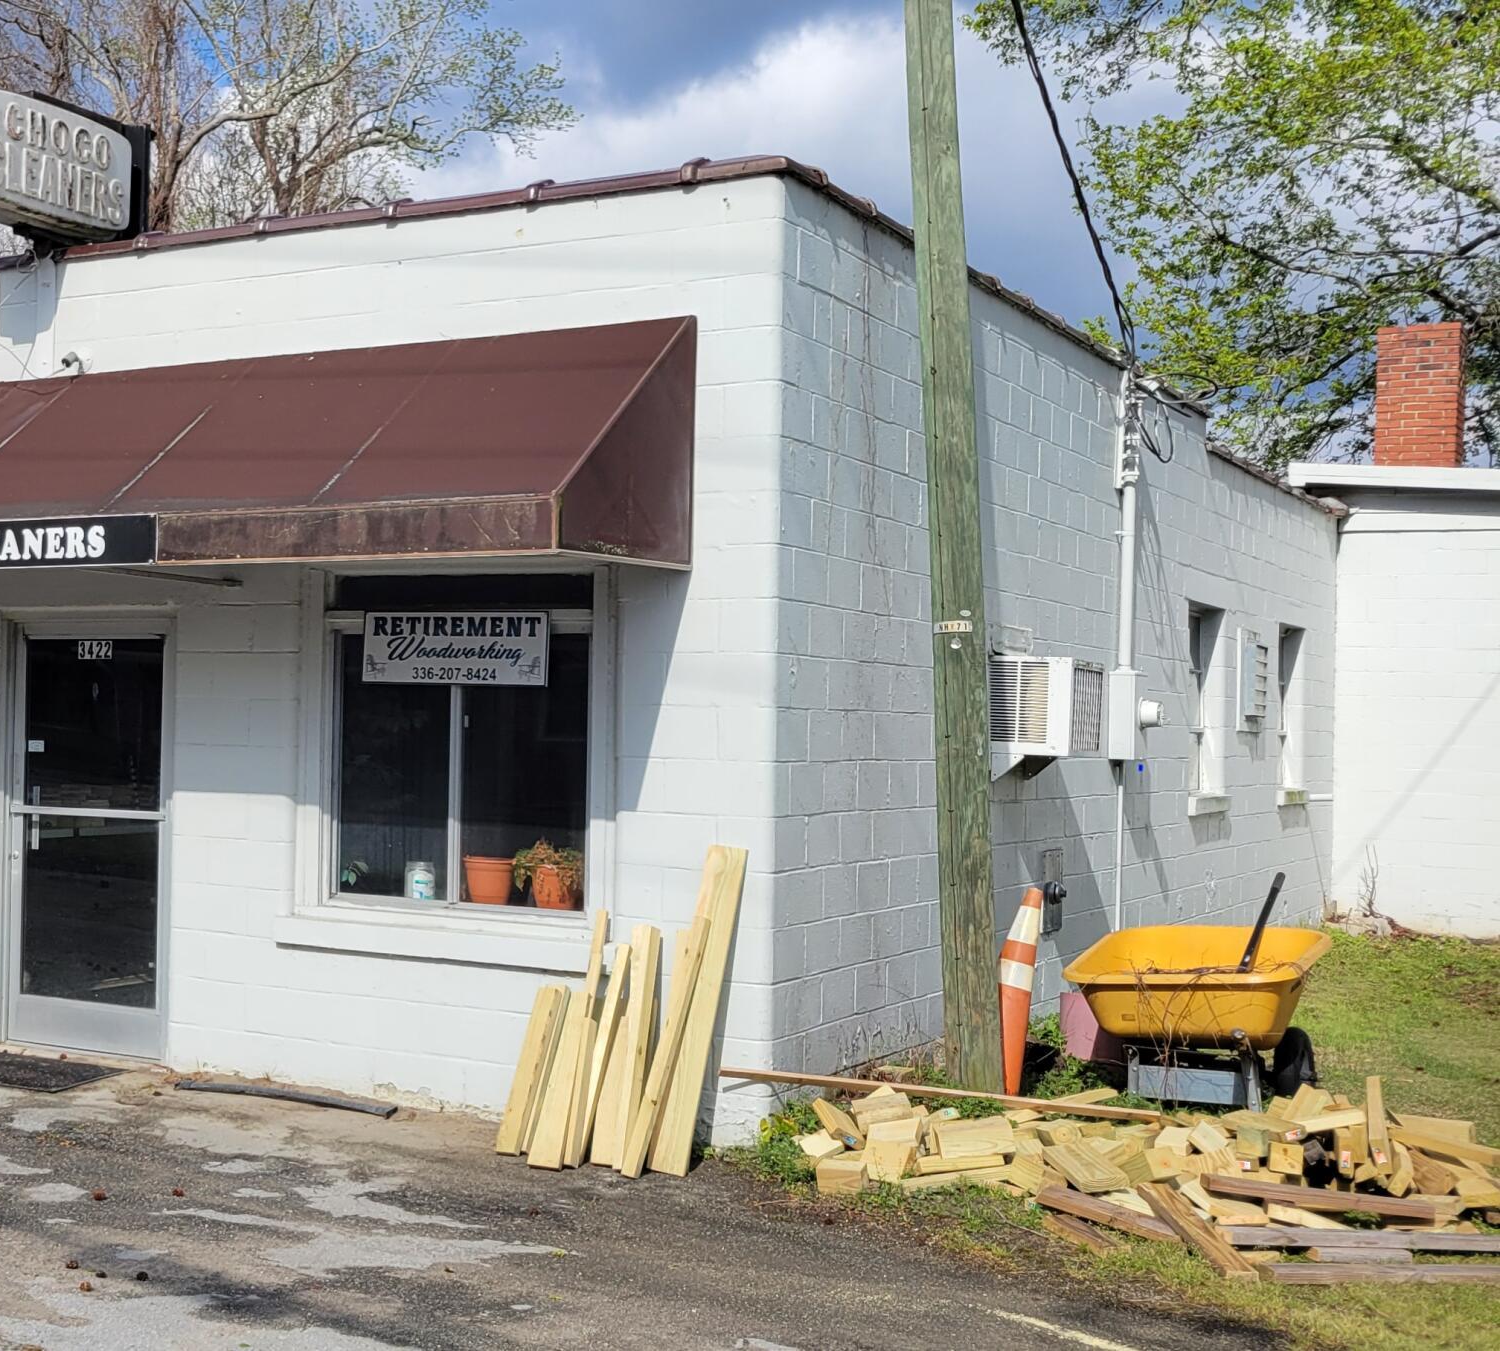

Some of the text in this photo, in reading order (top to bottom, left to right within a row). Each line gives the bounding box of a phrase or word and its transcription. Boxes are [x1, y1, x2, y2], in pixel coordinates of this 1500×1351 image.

[4, 101, 112, 170] CHOCO
[373, 616, 541, 638] RETIREMENT
[79, 641, 111, 659] 3422
[387, 636, 525, 667] Woodworking
[412, 667, 497, 681] 336-207-8424
